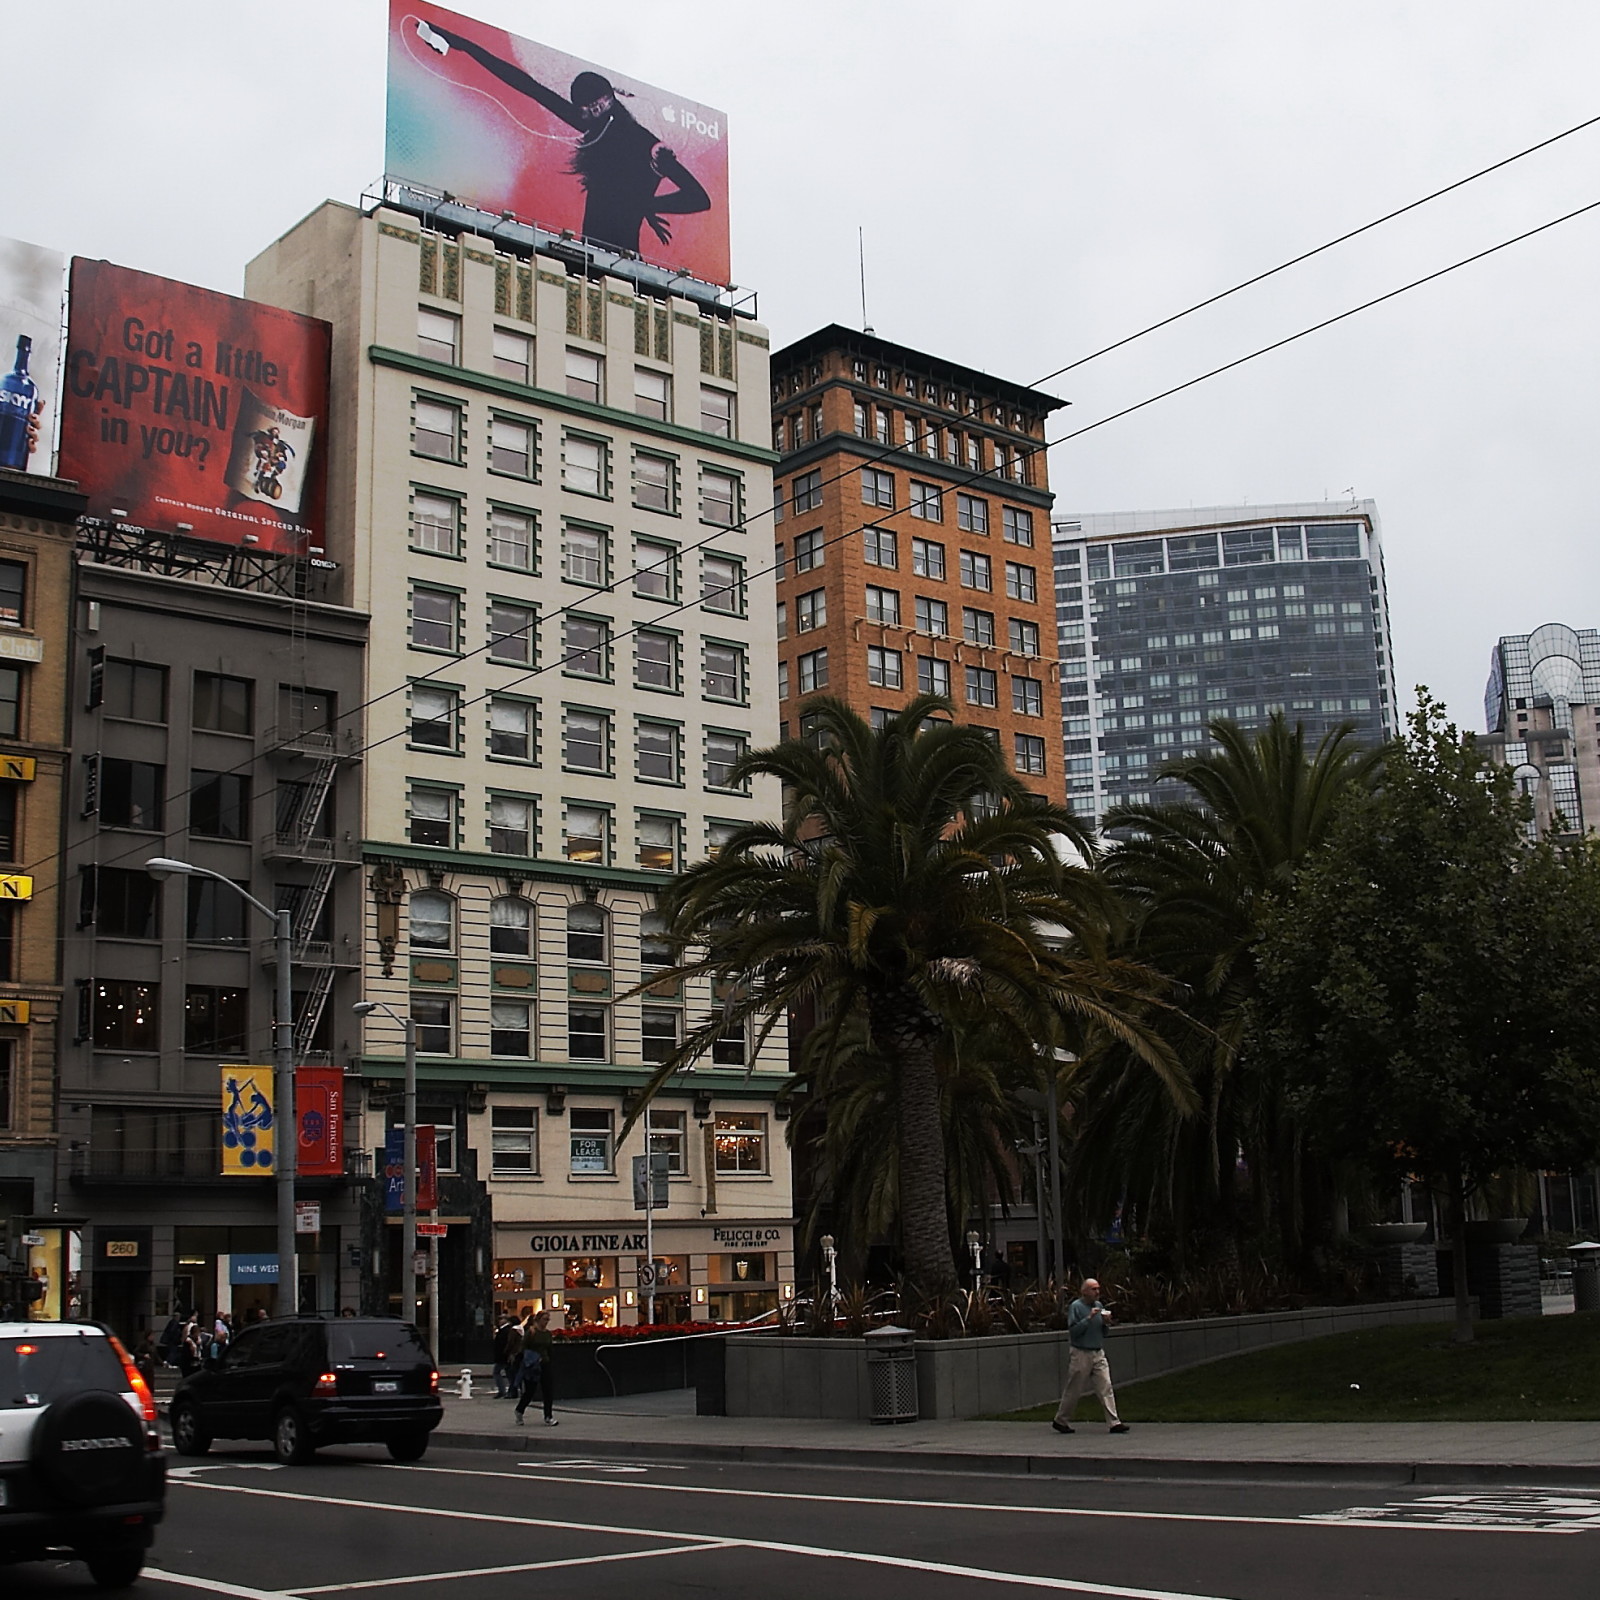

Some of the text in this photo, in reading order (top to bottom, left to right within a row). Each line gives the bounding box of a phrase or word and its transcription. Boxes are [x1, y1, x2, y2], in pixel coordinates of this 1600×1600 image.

[681, 109, 719, 140] iPod
[123, 317, 278, 387] Got a little
[70, 349, 229, 430] CAPTAIN
[101, 407, 211, 471] in you?
[7, 761, 23, 778] N
[3, 881, 19, 898] N
[329, 1091, 339, 1163] San Francisco
[575, 1148, 601, 1156] LEASE
[580, 1140, 597, 1148] FOR
[531, 1235, 580, 1251] GIOIA
[581, 1234, 620, 1250] FINE
[713, 1227, 753, 1241] FELICCI
[755, 1230, 762, 1240] &
[111, 1243, 134, 1254] 260
[237, 1264, 280, 1273] NINE WEST
[60, 1436, 134, 1452] HONDA
